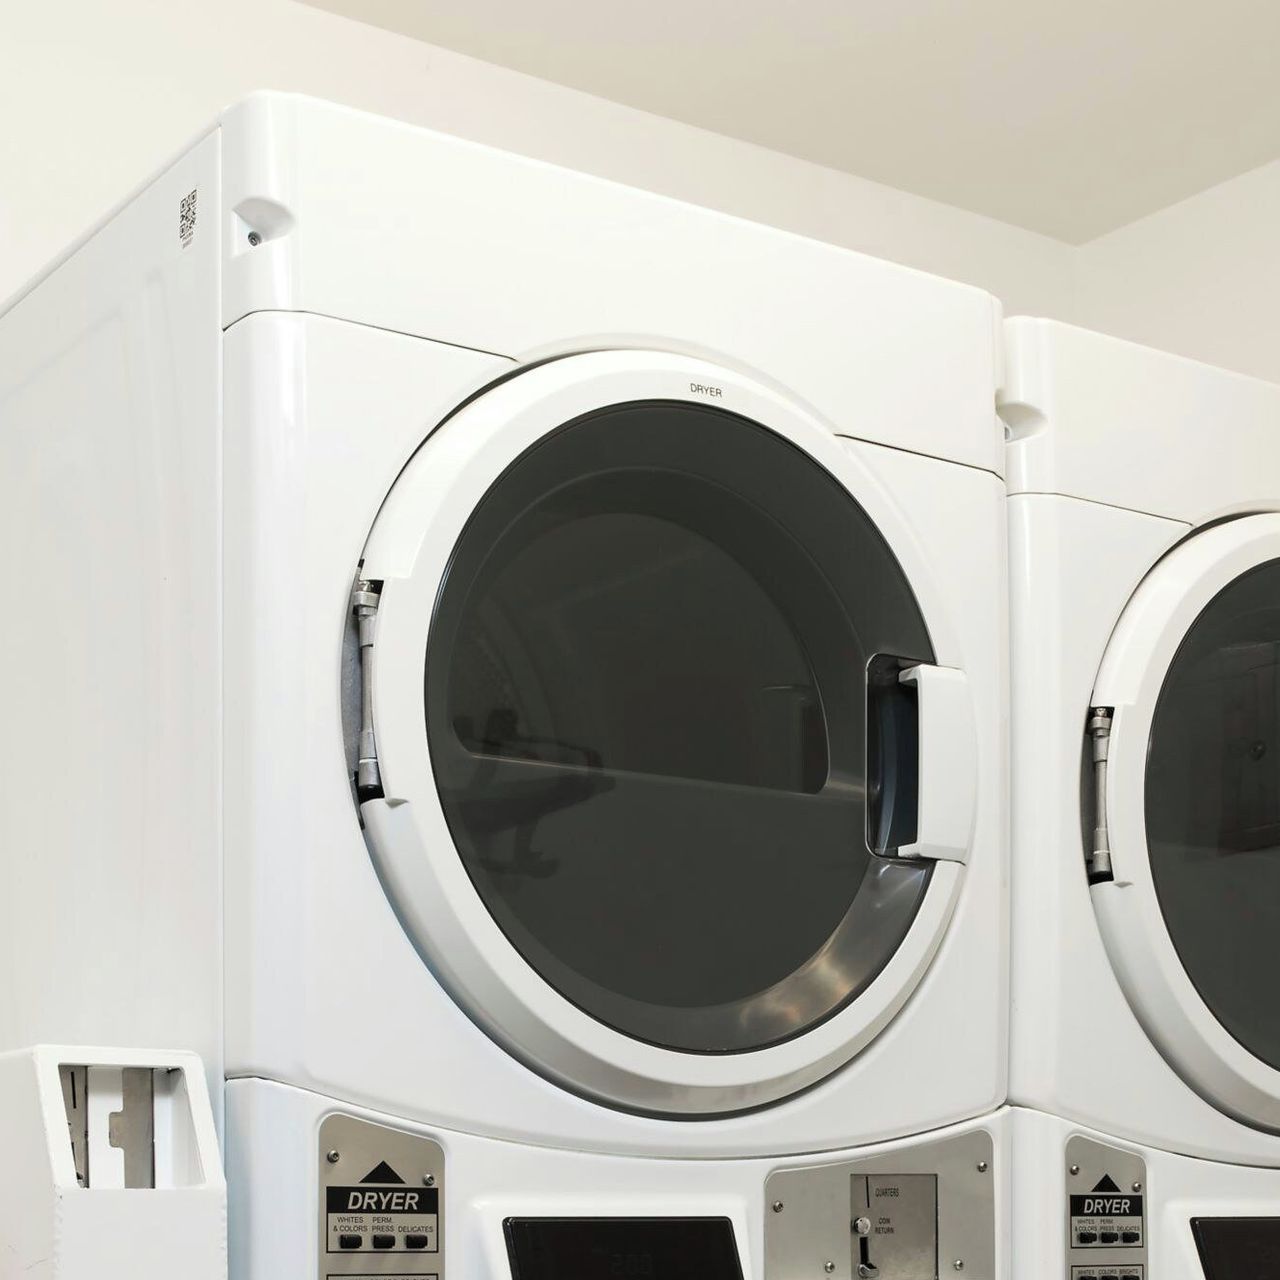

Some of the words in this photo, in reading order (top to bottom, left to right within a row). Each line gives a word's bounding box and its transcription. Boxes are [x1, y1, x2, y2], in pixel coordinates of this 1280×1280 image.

[690, 382, 723, 398] DRYER
[347, 1191, 419, 1211] DRYER
[1083, 1198, 1131, 1214] DRYER
[337, 1216, 364, 1224] WHITES
[339, 1225, 369, 1233] COLORS
[371, 1225, 395, 1233] PRESS
[397, 1225, 434, 1233] DELICATES
